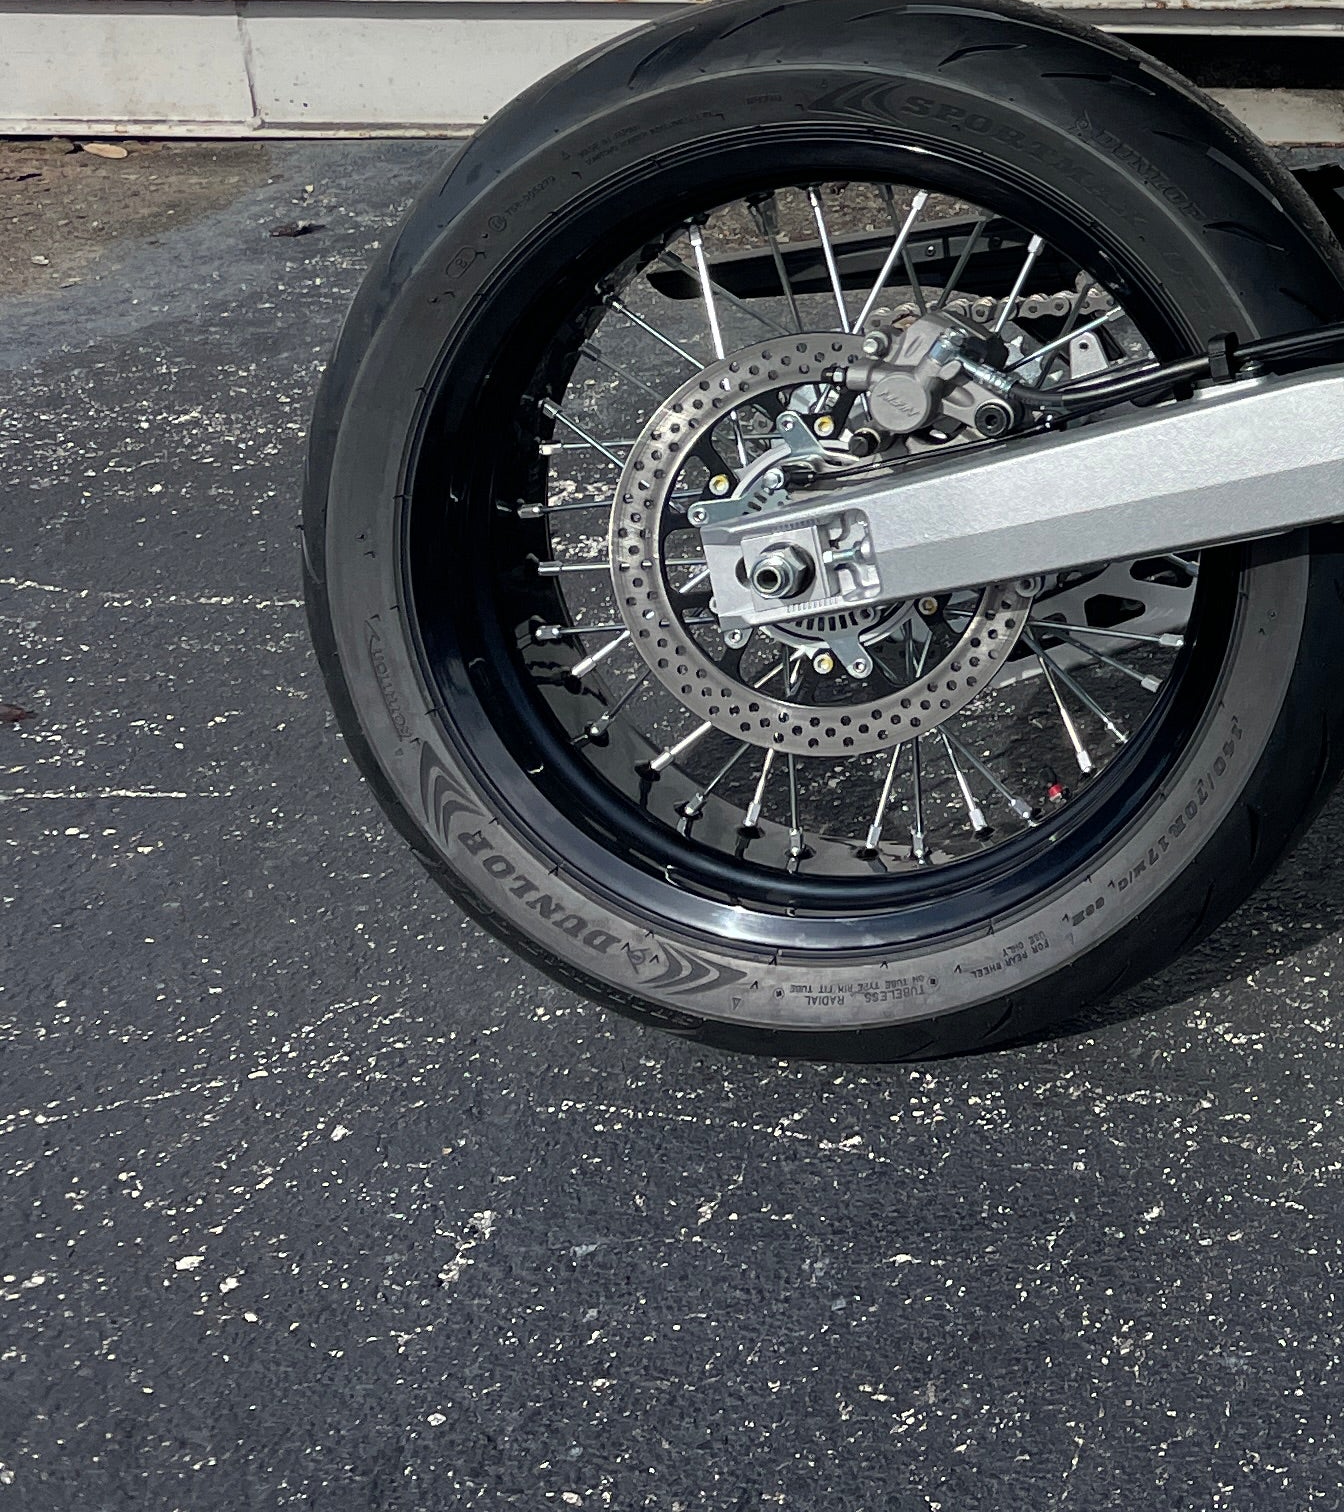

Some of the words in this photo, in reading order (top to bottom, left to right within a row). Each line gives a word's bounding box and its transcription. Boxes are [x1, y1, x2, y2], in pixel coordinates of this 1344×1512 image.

[1093, 125, 1206, 225] DUNLOP
[457, 829, 620, 954] DUNLOP
[1026, 937, 1051, 956] FOR
[1002, 949, 1028, 967] REAR
[803, 994, 845, 1005] RADIAL
[864, 983, 925, 1002] TUBELESS
